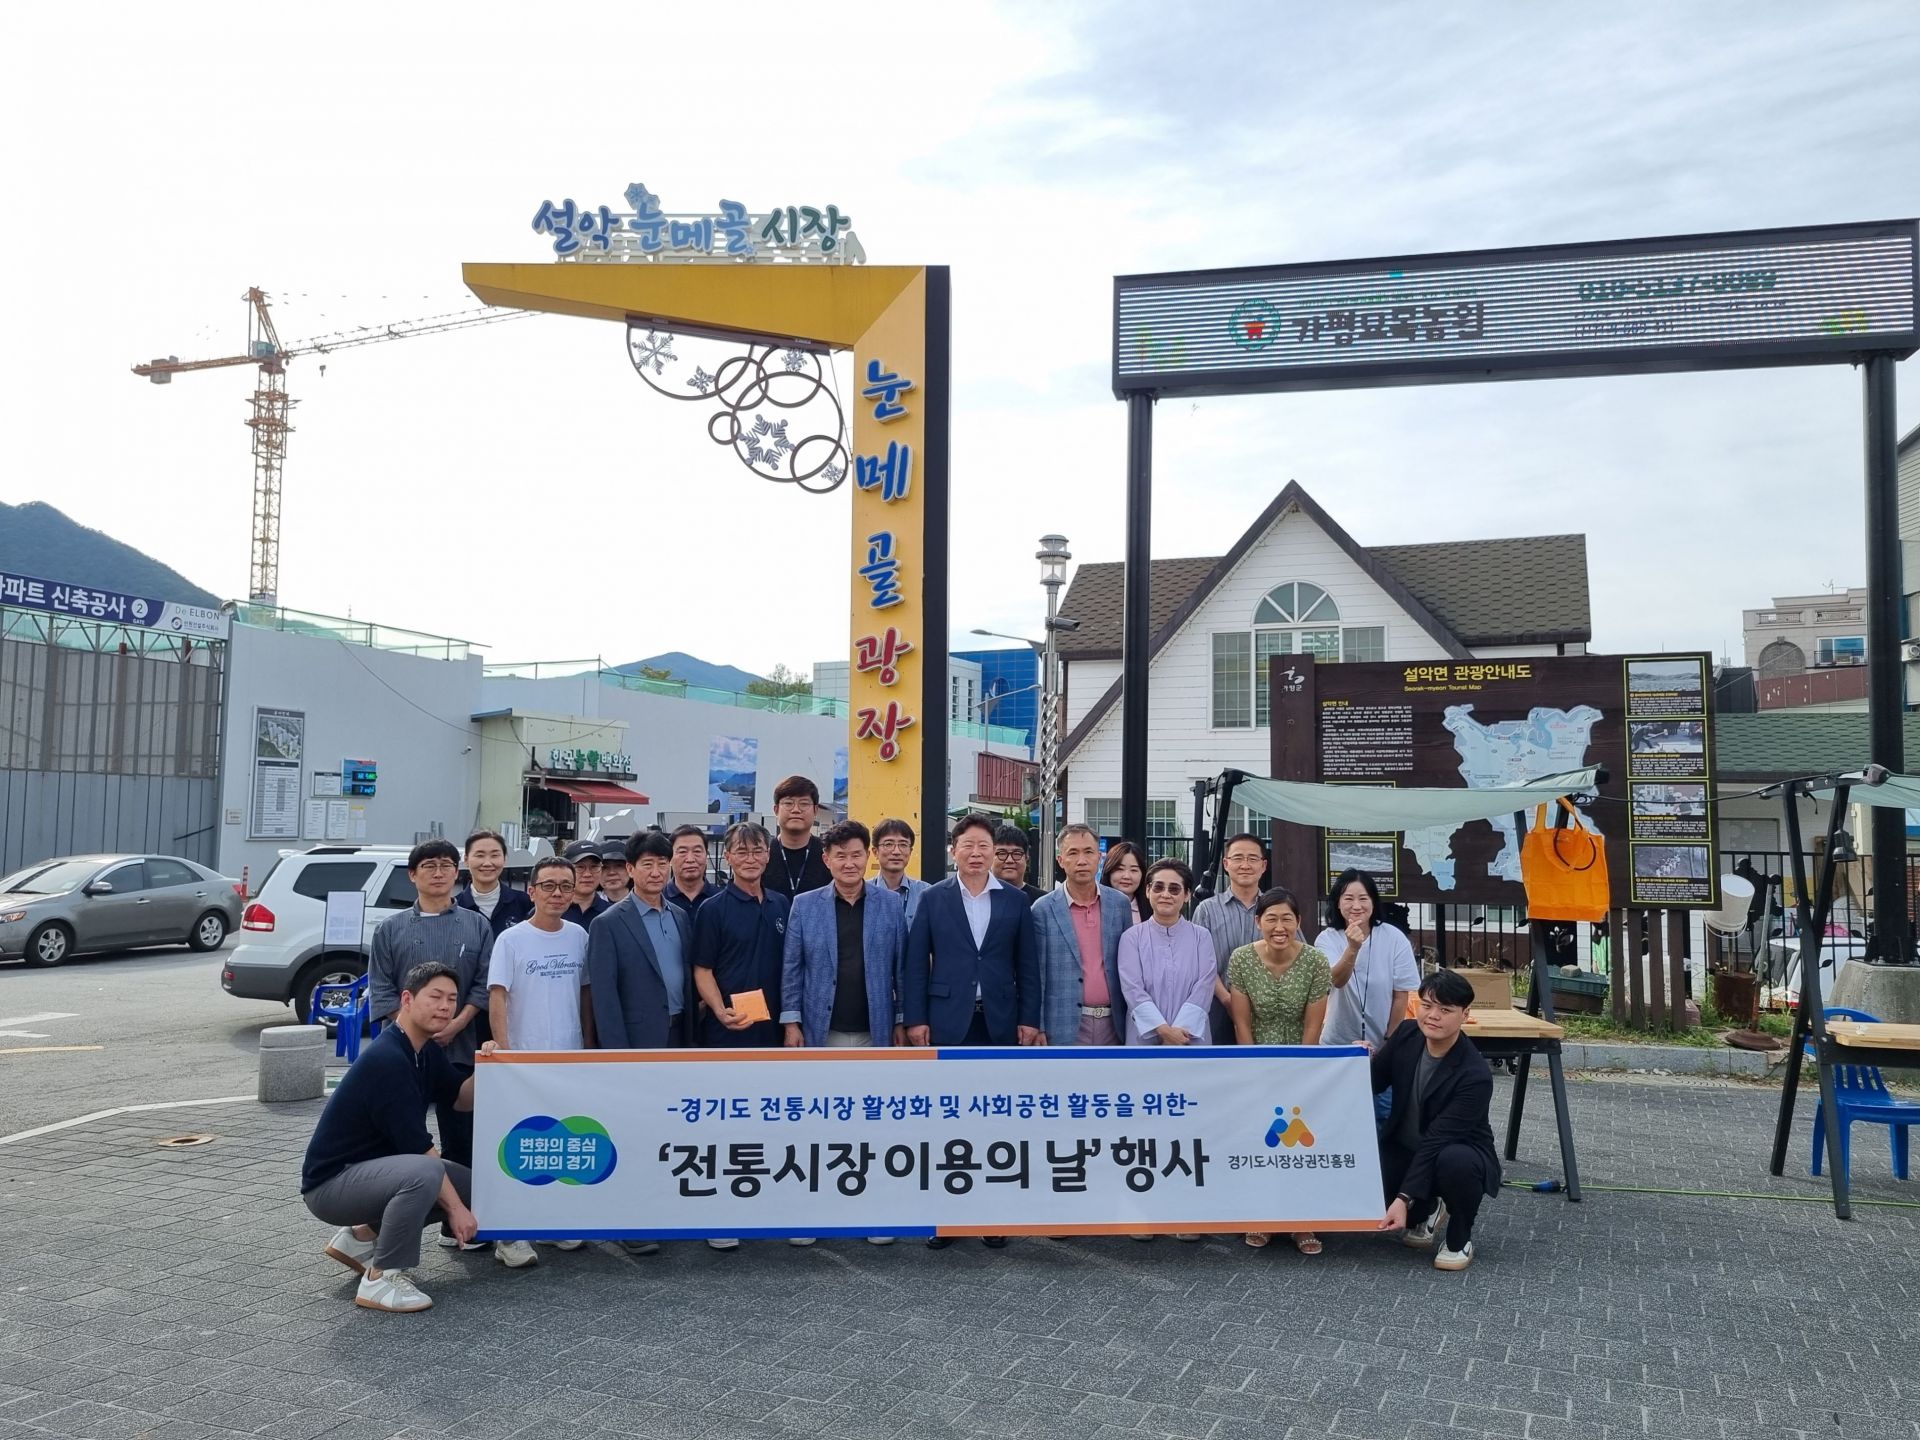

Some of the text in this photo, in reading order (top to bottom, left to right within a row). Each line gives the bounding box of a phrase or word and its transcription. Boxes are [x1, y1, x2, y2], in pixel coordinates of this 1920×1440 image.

[532, 196, 851, 257] 설악 눈메골 시장
[50, 585, 127, 620] 신축공사
[132, 618, 146, 626] GATE
[189, 608, 220, 621] ELBON
[1403, 664, 1532, 682] 설악면 관광안내도
[525, 959, 549, 976] Good
[666, 1092, 1199, 1123] -경기도 전통시장 활성화 및 사회공헌 활동을 위한-
[519, 1137, 597, 1154] 변화의 중심
[518, 1154, 597, 1171] 기회의 경기
[883, 1138, 1031, 1195] 이용의
[1110, 1134, 1211, 1193] 행사
[1227, 1152, 1357, 1171] 경기도시장상권진흥원
